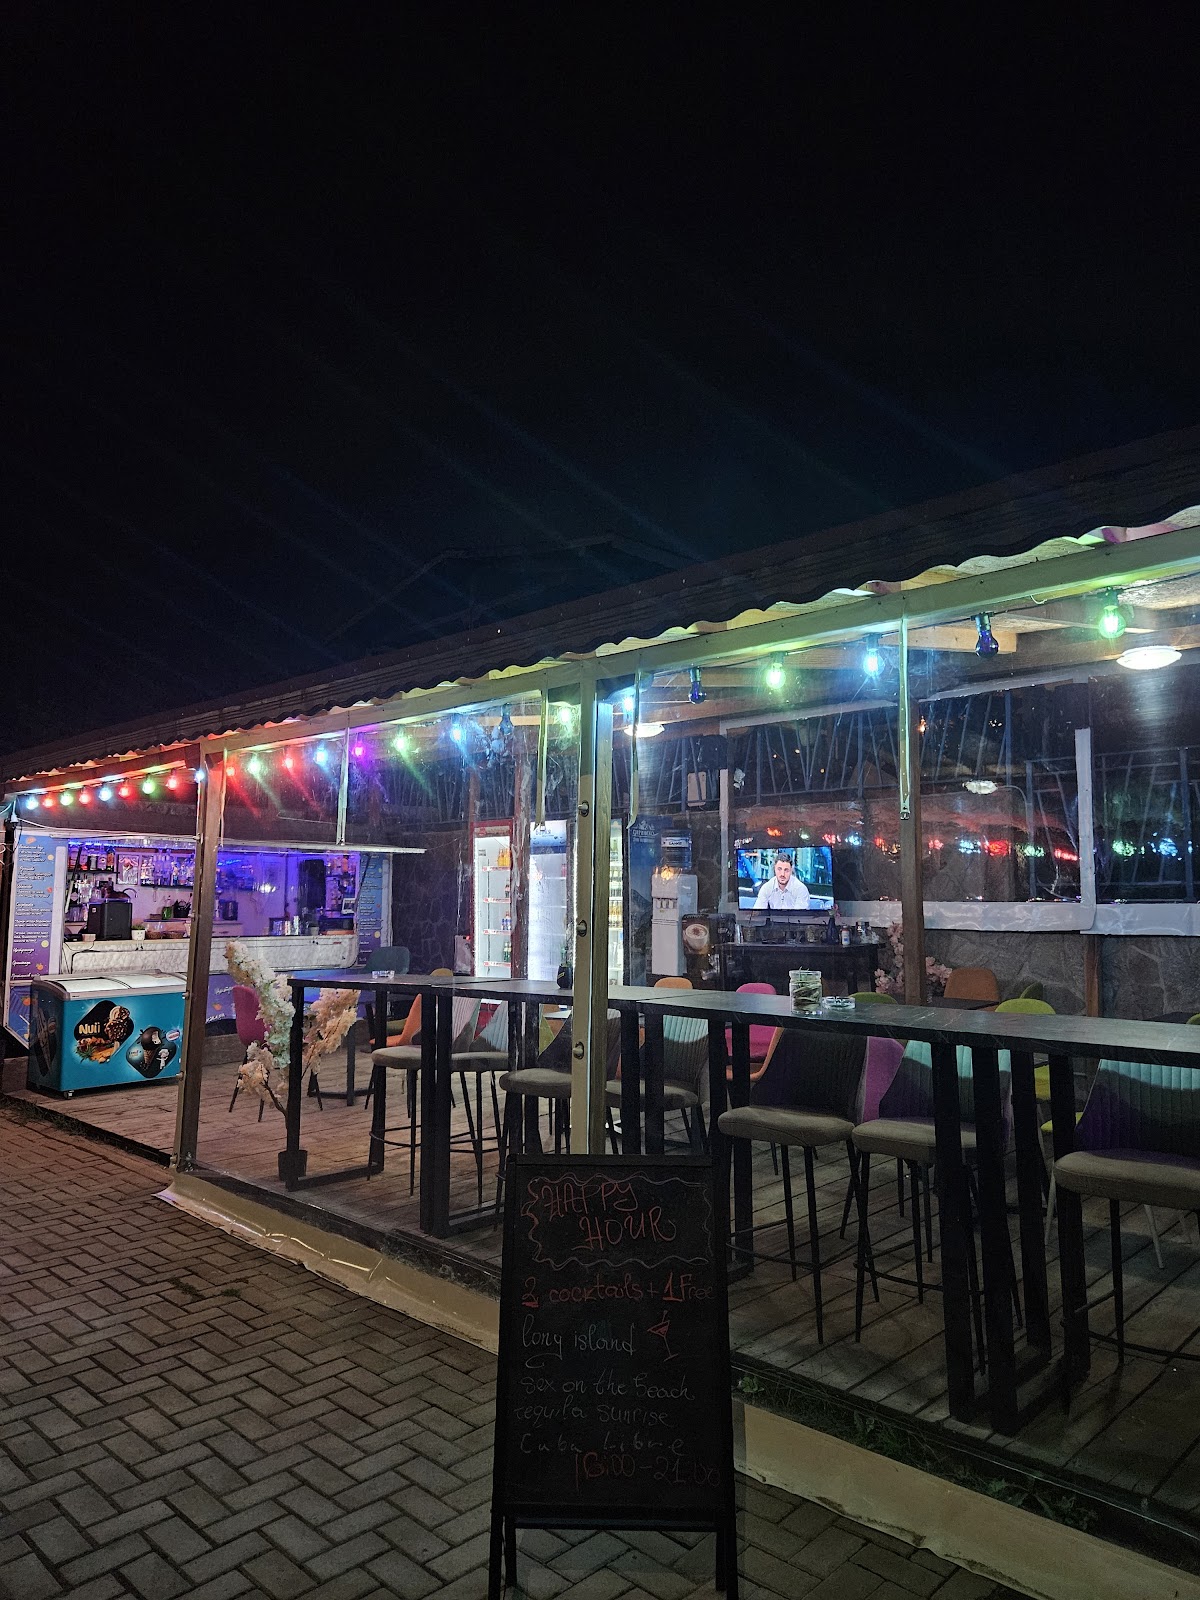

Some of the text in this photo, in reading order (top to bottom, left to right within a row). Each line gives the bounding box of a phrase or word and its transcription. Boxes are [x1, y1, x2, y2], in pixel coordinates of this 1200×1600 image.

[541, 1181, 638, 1222] HAPPY
[571, 1205, 677, 1251] HOUR
[522, 1276, 540, 1307] 2
[548, 1273, 644, 1304] cocktails
[573, 1322, 637, 1355] island
[562, 1378, 588, 1395] on
[593, 1368, 629, 1396] the
[520, 1432, 583, 1455] Cuba
